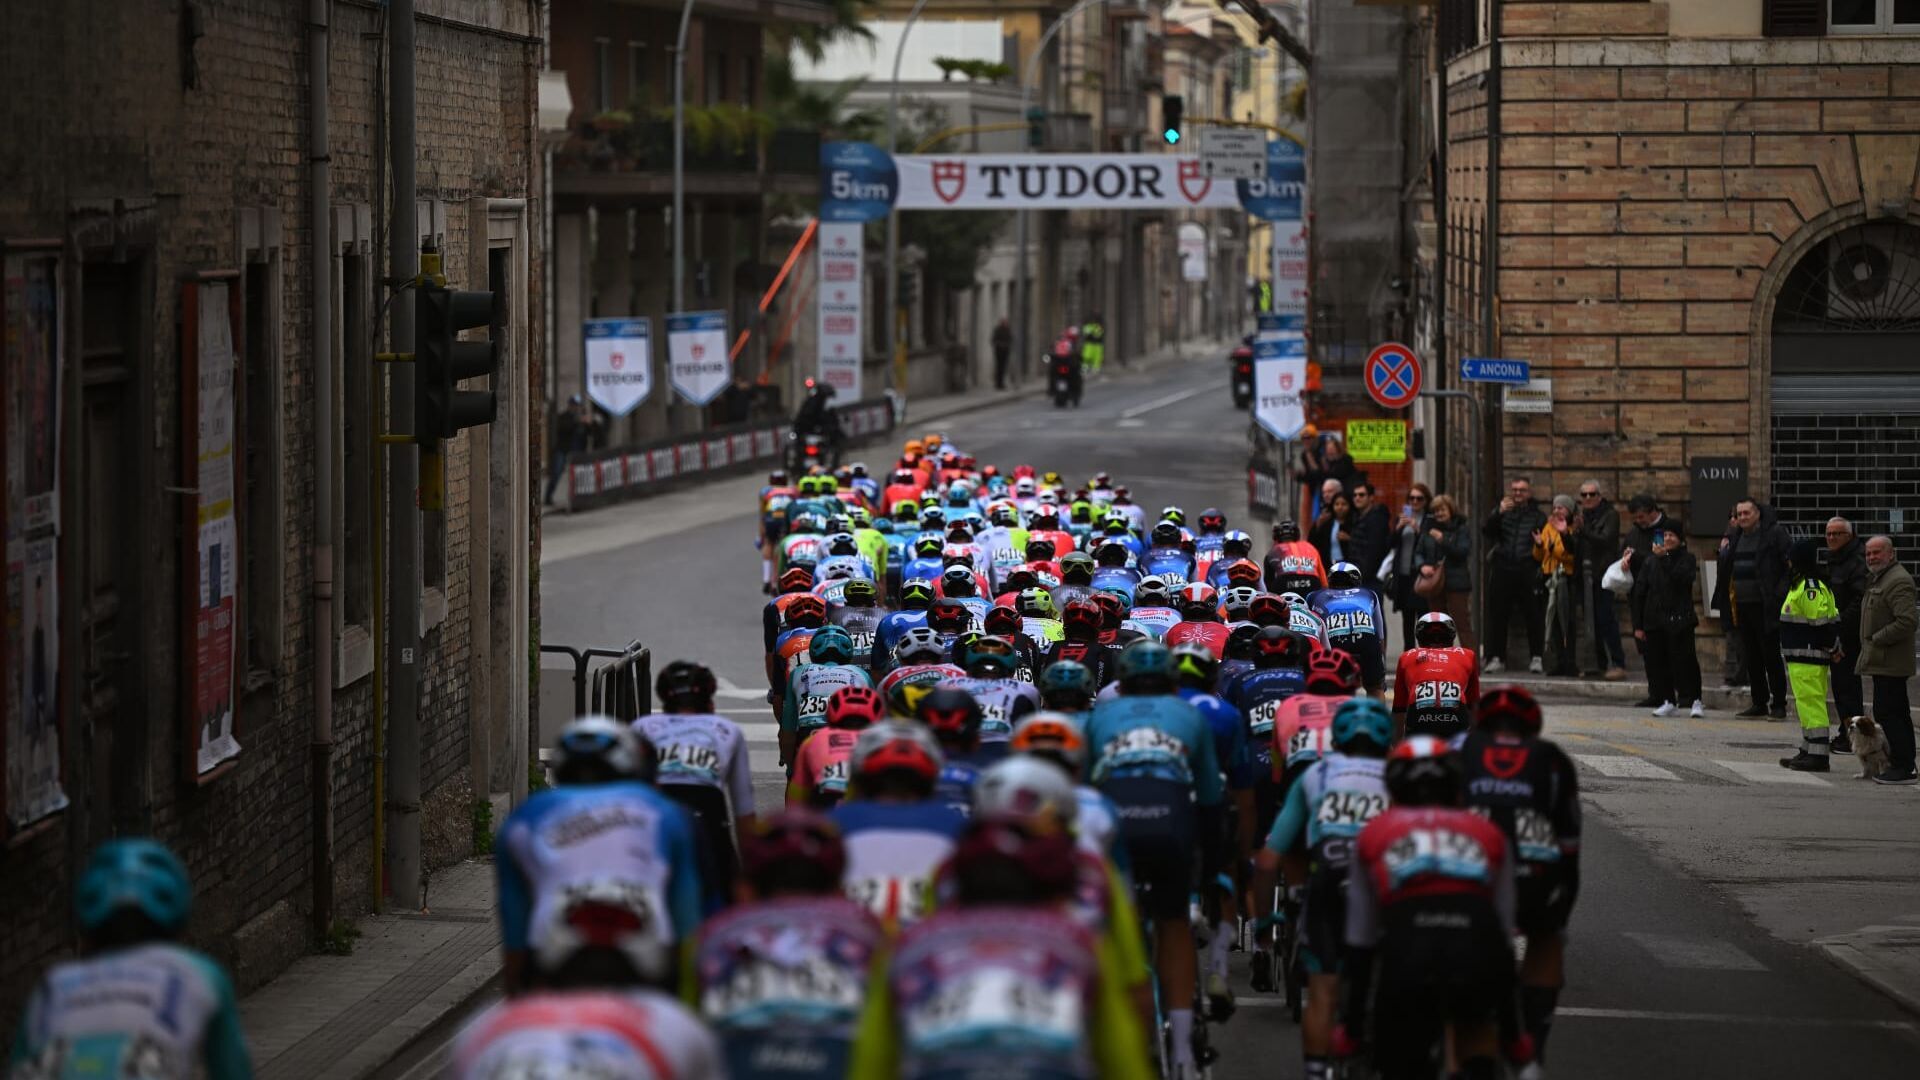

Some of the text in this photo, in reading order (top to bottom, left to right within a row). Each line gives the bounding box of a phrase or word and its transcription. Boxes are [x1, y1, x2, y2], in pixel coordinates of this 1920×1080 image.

[831, 171, 889, 201] 5km
[979, 165, 1163, 198] TUDOR
[1479, 363, 1522, 378] ANCONA
[1261, 396, 1304, 408] TUDO
[1699, 467, 1740, 480] ADIM
[1287, 580, 1312, 588] INEOS
[1328, 613, 1347, 630] 127
[1416, 682, 1459, 699] 25 25
[799, 696, 827, 716] 235
[1255, 701, 1276, 722] 96
[1418, 714, 1460, 723] ARKEA
[1290, 729, 1309, 753] 87
[823, 761, 843, 778] 81
[1469, 777, 1534, 796] TUDOR
